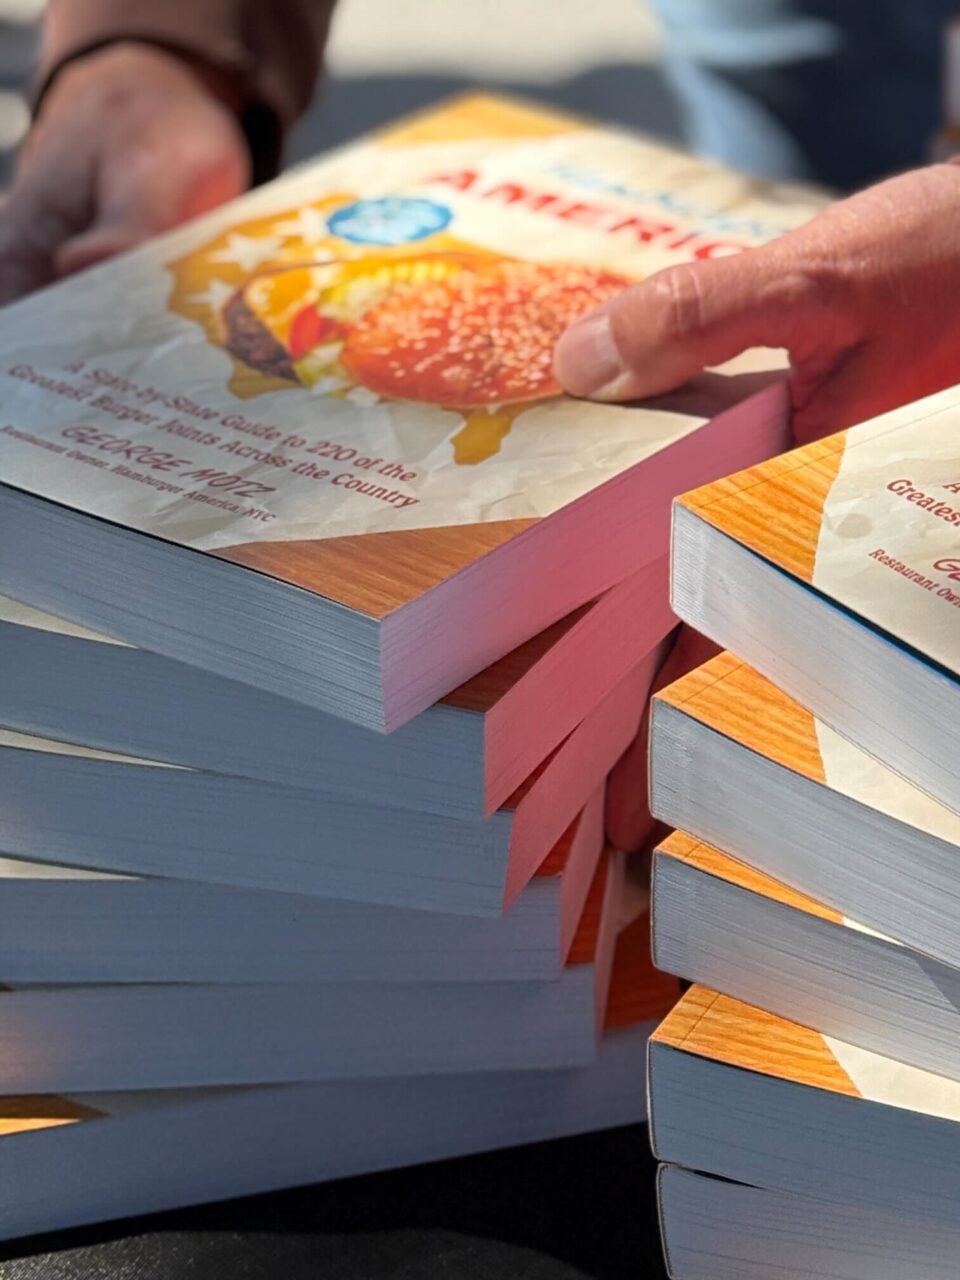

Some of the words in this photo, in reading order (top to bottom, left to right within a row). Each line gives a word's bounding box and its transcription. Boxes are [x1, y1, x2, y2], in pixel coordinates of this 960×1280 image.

[60, 425, 194, 471] GEORGE
[178, 468, 277, 498] MOTZ
[156, 419, 221, 446] Joints
[218, 440, 293, 468] Across
[291, 461, 331, 481] the
[330, 472, 421, 509] Country
[220, 415, 282, 441] Guide
[282, 434, 307, 448] to
[305, 441, 358, 462] 220
[353, 456, 384, 471] of
[378, 463, 417, 483] the
[110, 464, 186, 494] Hamburger
[242, 506, 277, 523] NYC
[867, 548, 939, 593] Restaurant
